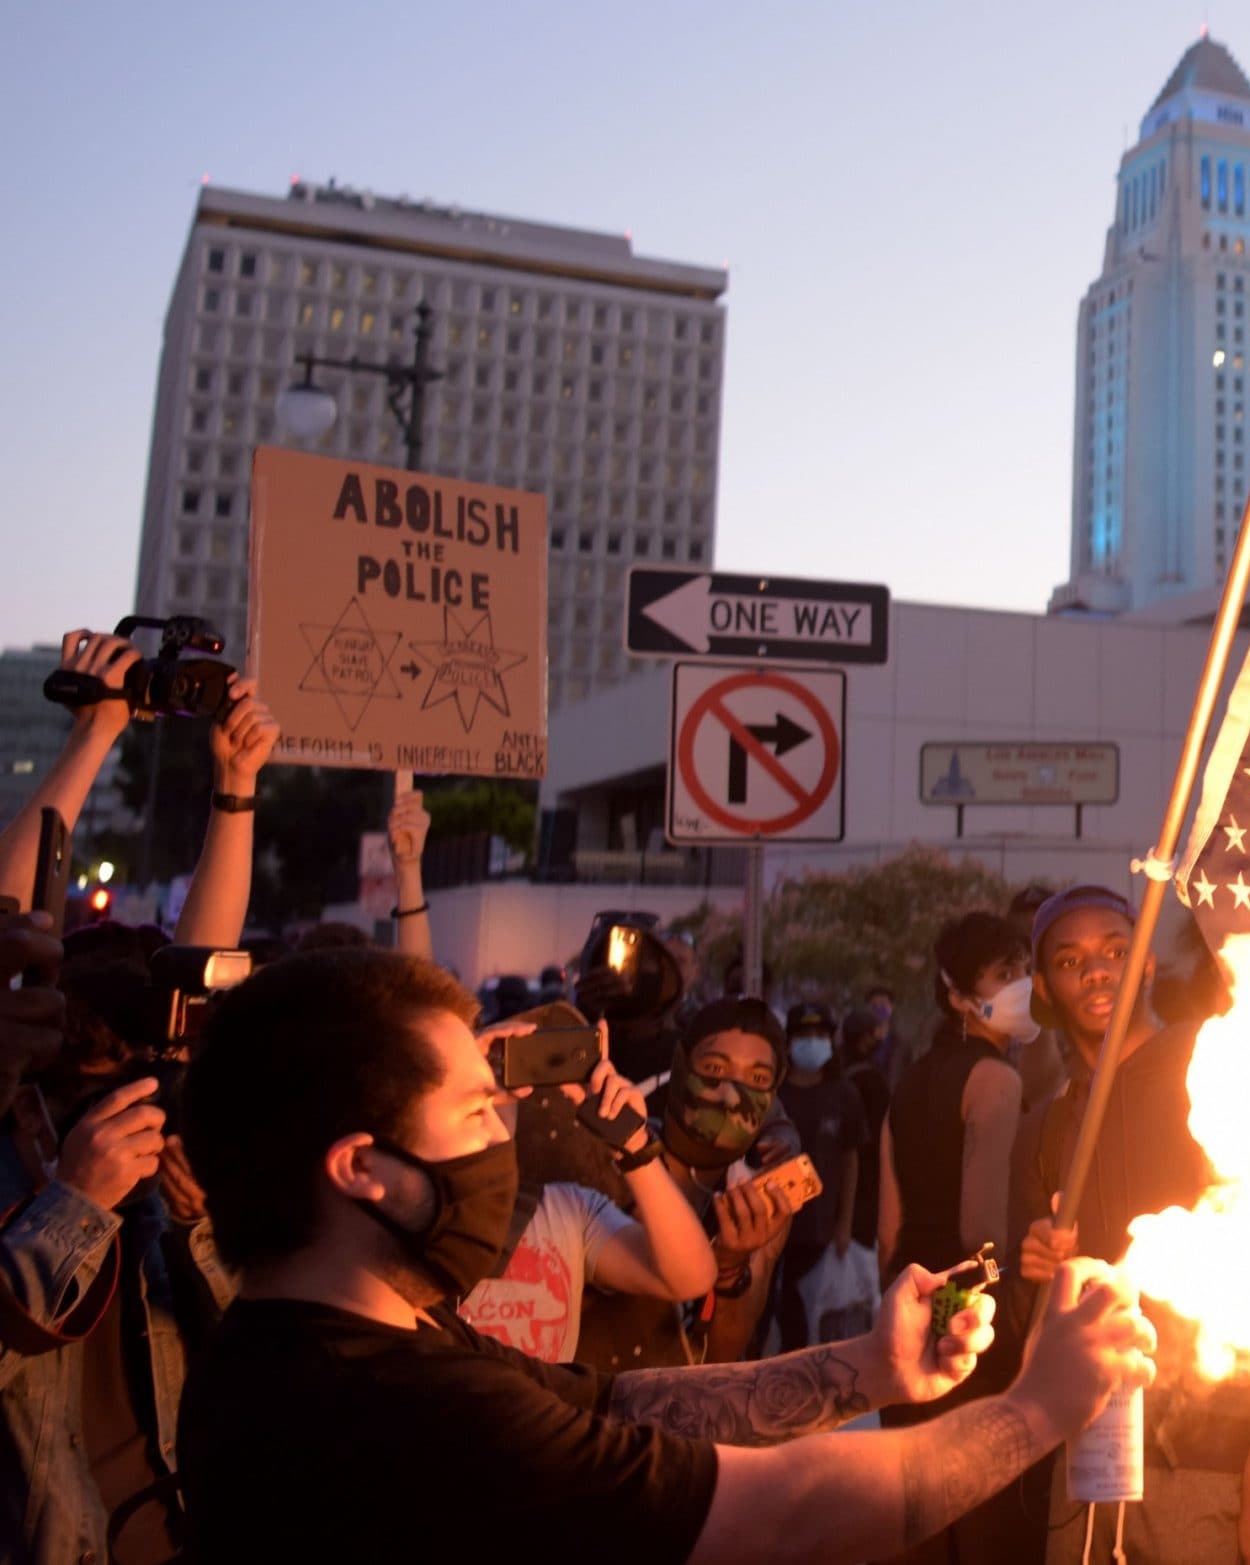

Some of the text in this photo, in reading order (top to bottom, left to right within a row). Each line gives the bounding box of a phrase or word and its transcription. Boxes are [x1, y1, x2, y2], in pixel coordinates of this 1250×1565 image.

[333, 473, 520, 553] ABOLISH
[401, 540, 445, 562] THE
[357, 555, 490, 611] POLICE
[710, 599, 862, 638] ONE WAY
[332, 664, 376, 683] PATROL
[494, 751, 545, 777] BLACK
